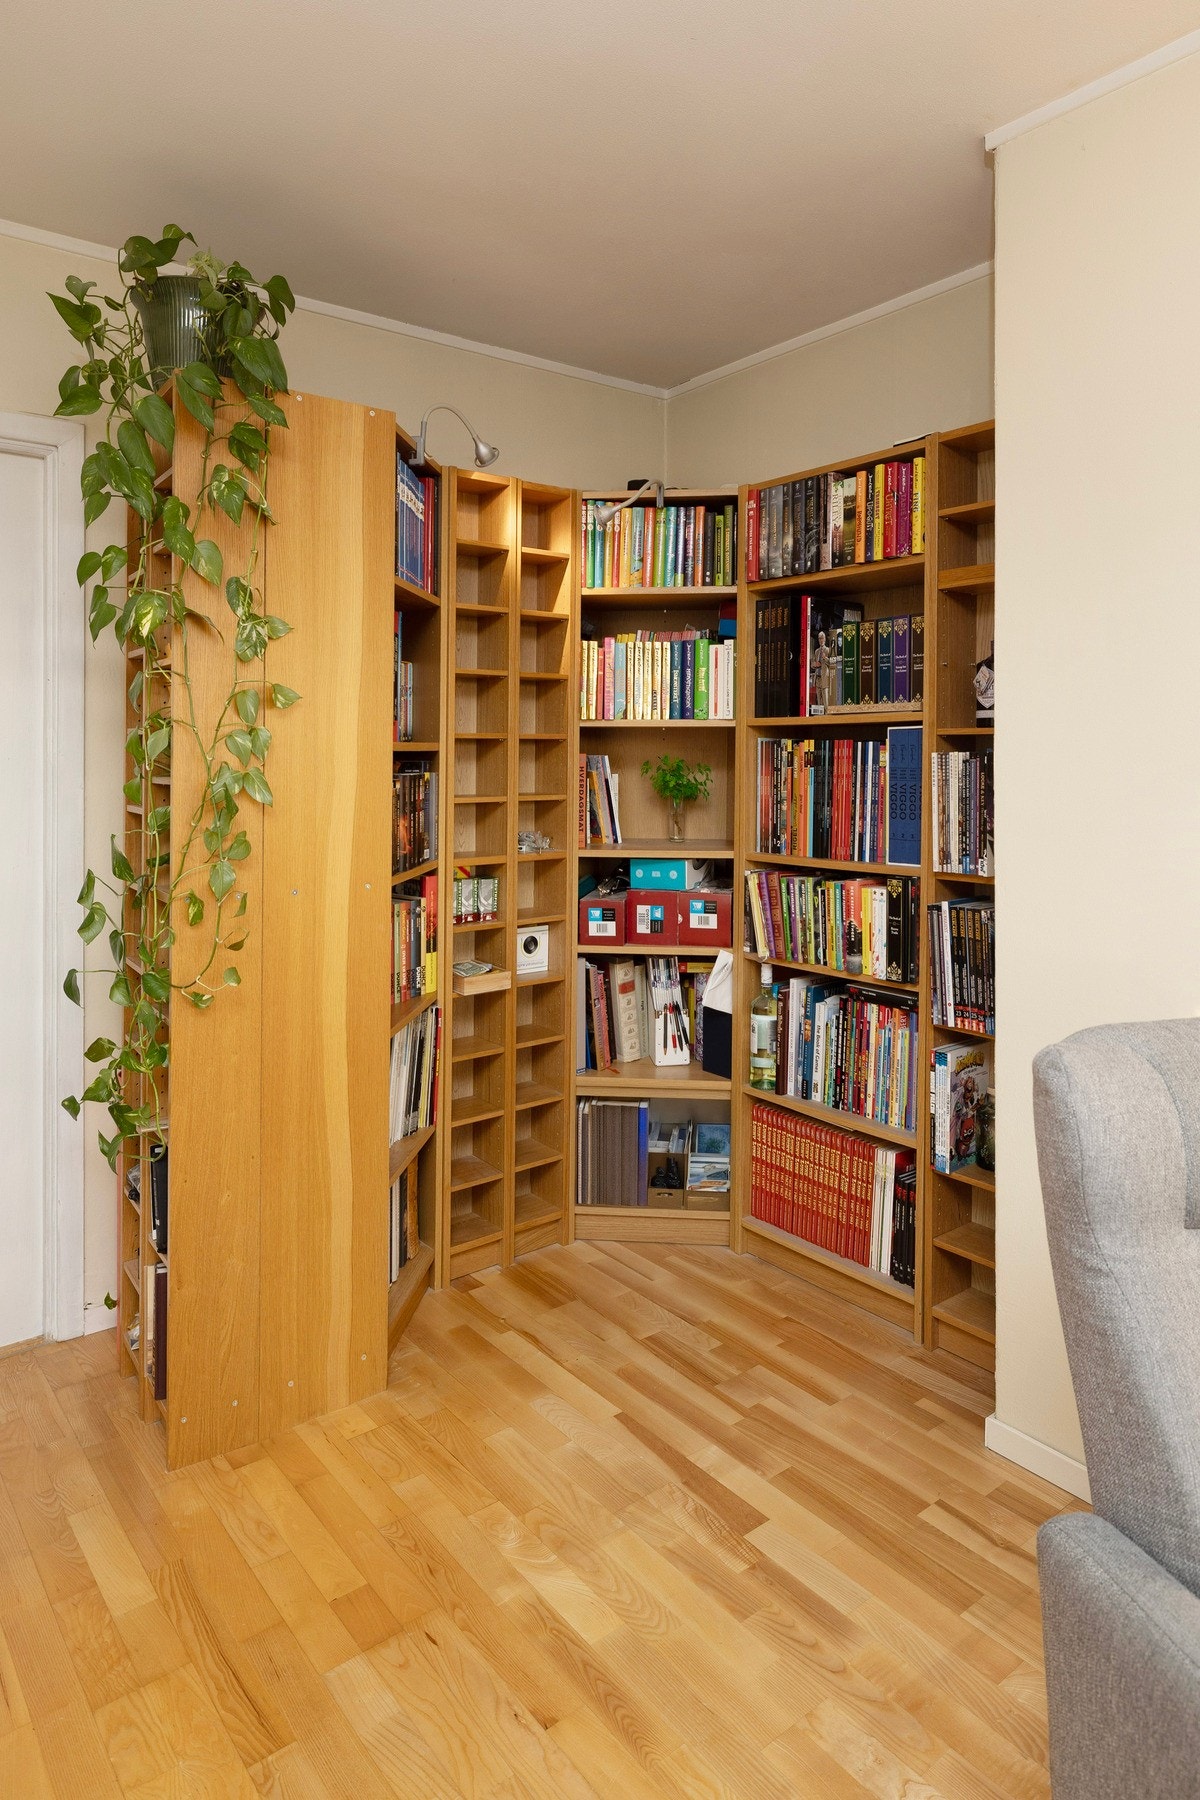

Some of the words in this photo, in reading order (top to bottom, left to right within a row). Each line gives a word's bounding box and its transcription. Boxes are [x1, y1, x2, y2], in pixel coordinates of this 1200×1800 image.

[890, 783, 898, 819] VIGGO
[899, 784, 907, 821] VIGGO
[909, 784, 917, 821] VIGGO
